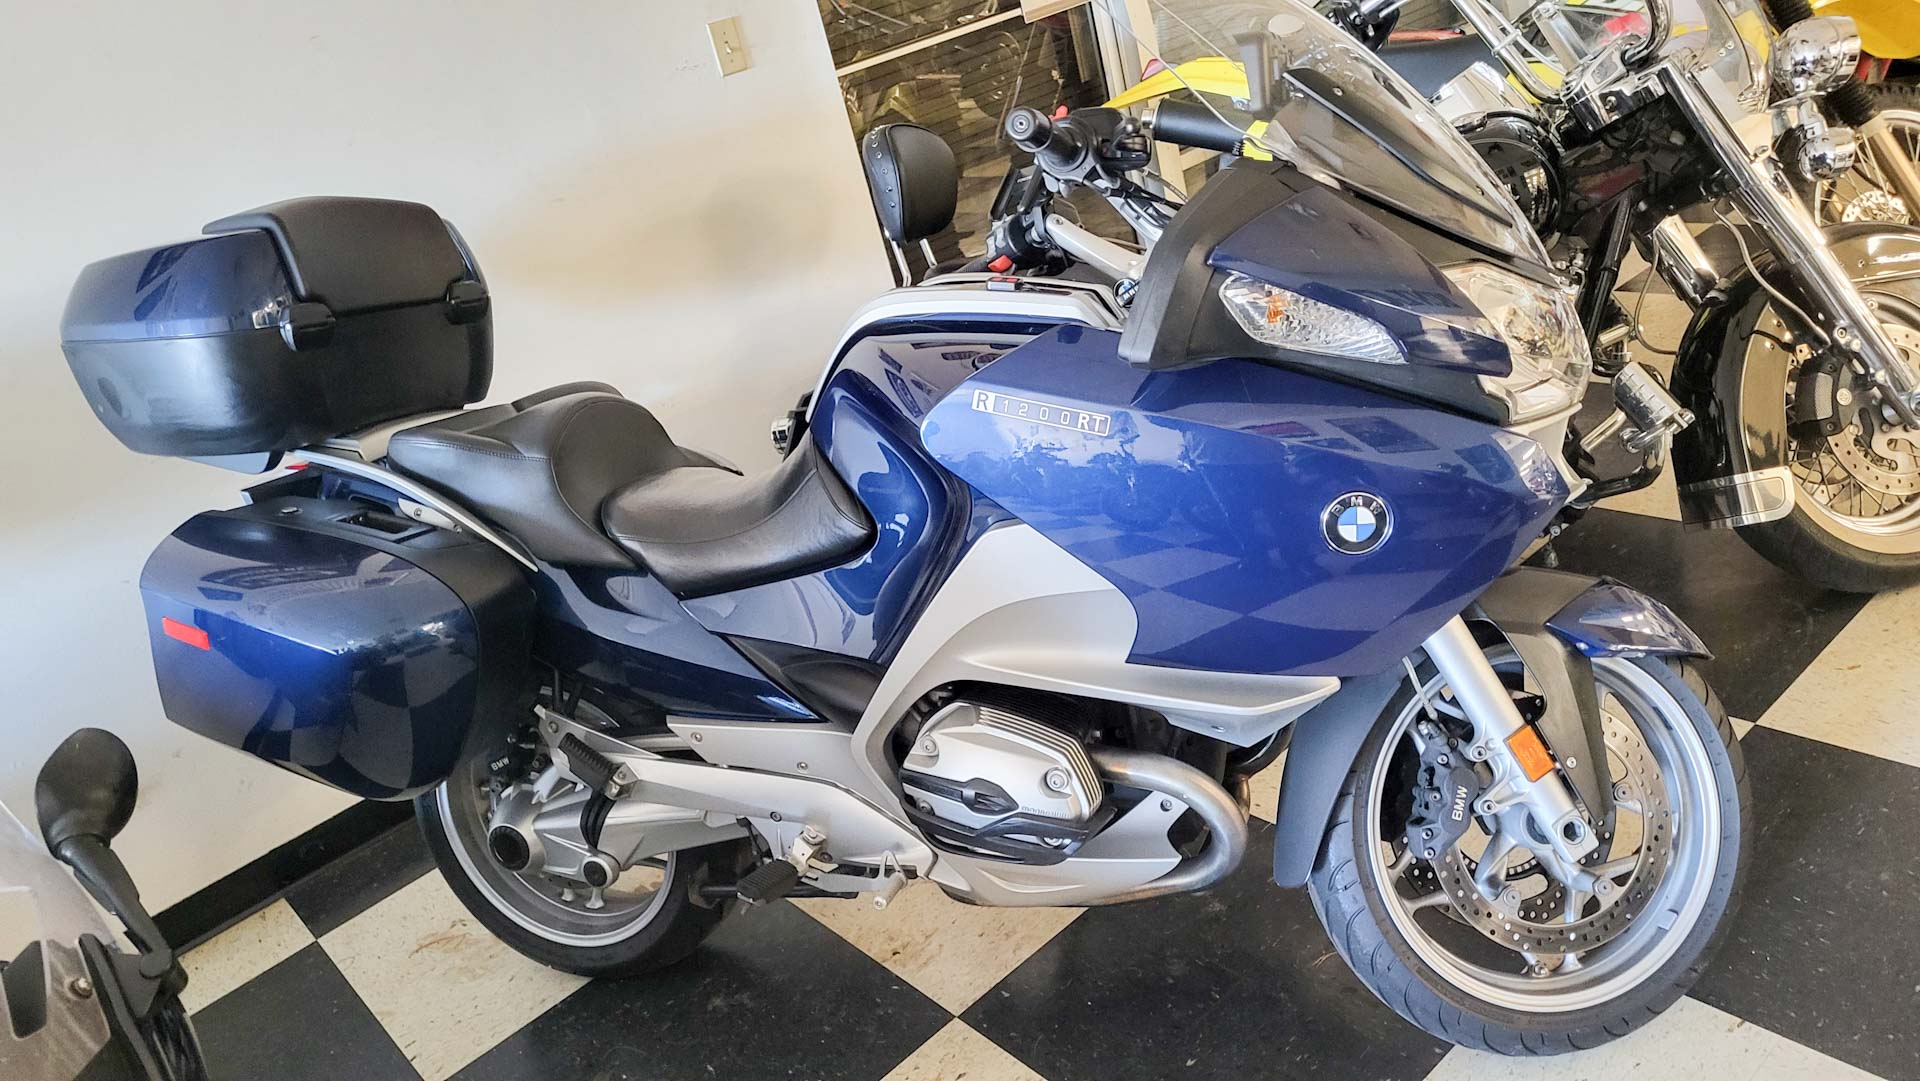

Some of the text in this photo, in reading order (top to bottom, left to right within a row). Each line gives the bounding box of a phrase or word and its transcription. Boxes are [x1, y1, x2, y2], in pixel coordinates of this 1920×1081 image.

[976, 391, 989, 411] R
[490, 756, 510, 771] BMW
[1451, 785, 1468, 821] BMW
